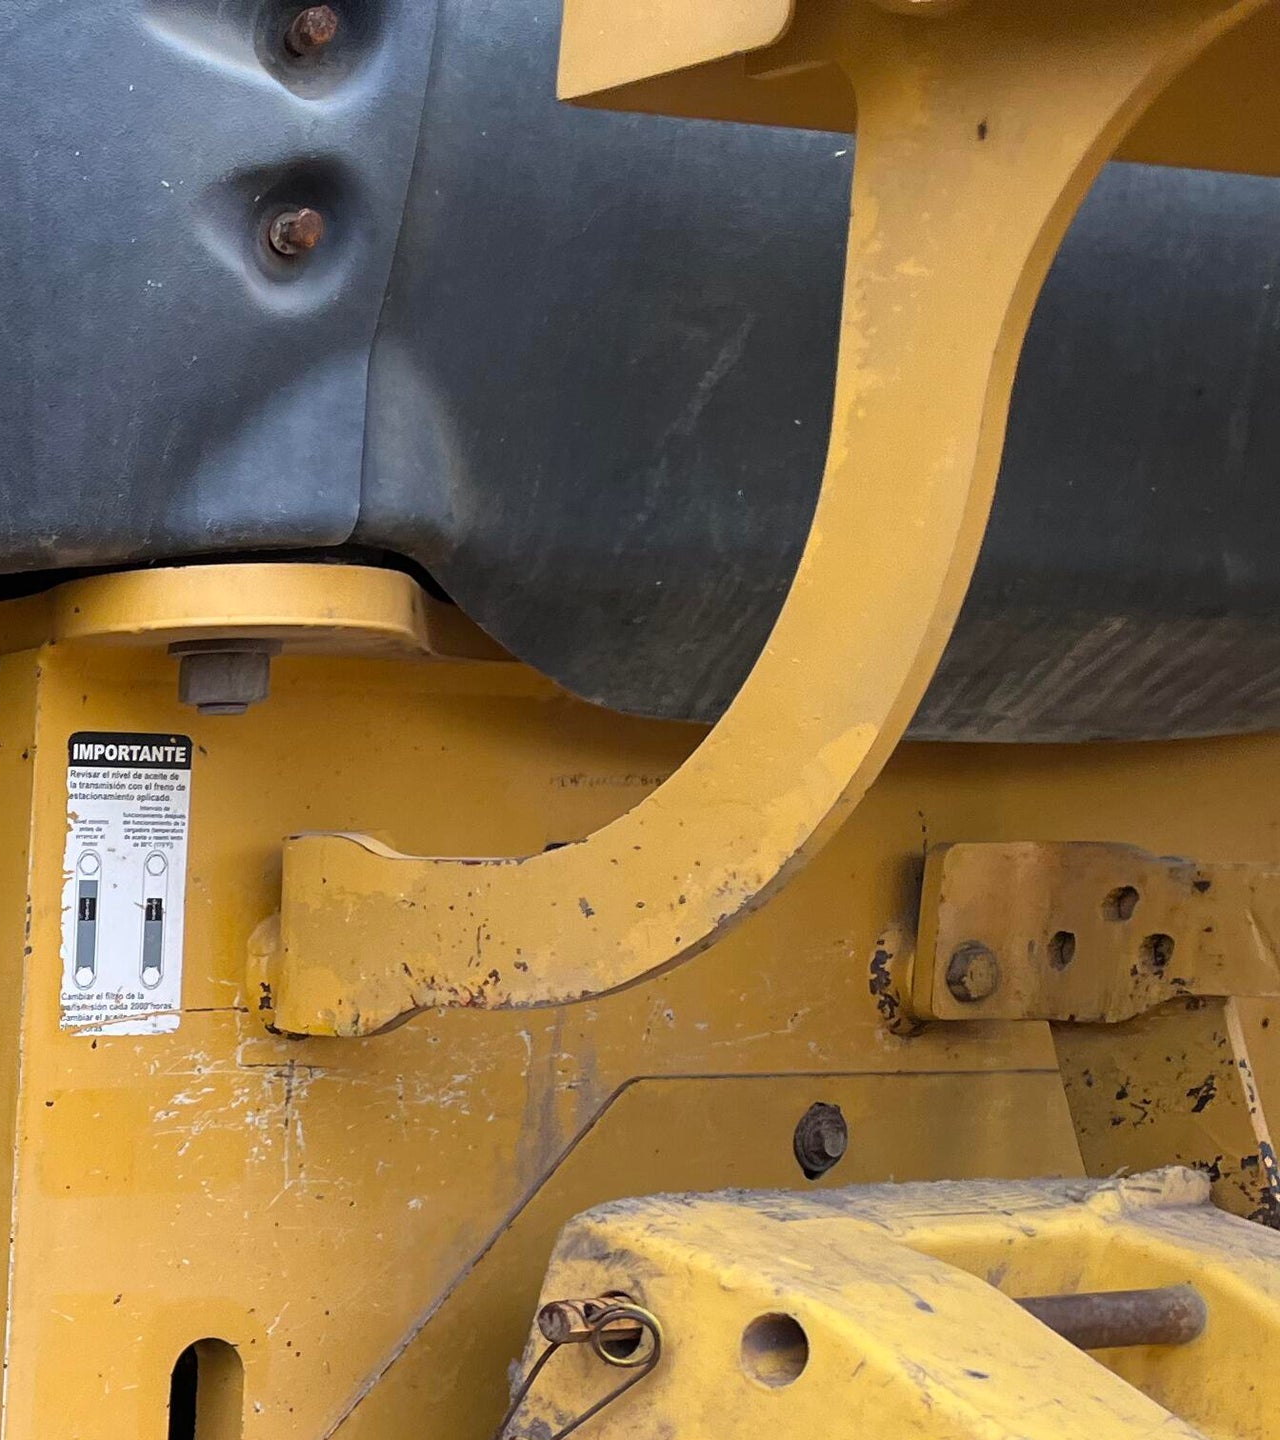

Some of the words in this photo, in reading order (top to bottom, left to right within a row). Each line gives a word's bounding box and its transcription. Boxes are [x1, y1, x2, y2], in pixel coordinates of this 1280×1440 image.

[73, 744, 187, 763] IMPORTANTE
[70, 770, 100, 778] Revisar
[103, 770, 110, 779] el
[112, 771, 130, 779] nivel
[133, 771, 142, 779] de
[145, 772, 167, 780] aceite
[79, 781, 125, 790] transmisión
[154, 783, 174, 791] freno
[69, 792, 134, 801] estacionamiento
[61, 992, 94, 1000] Cambiar
